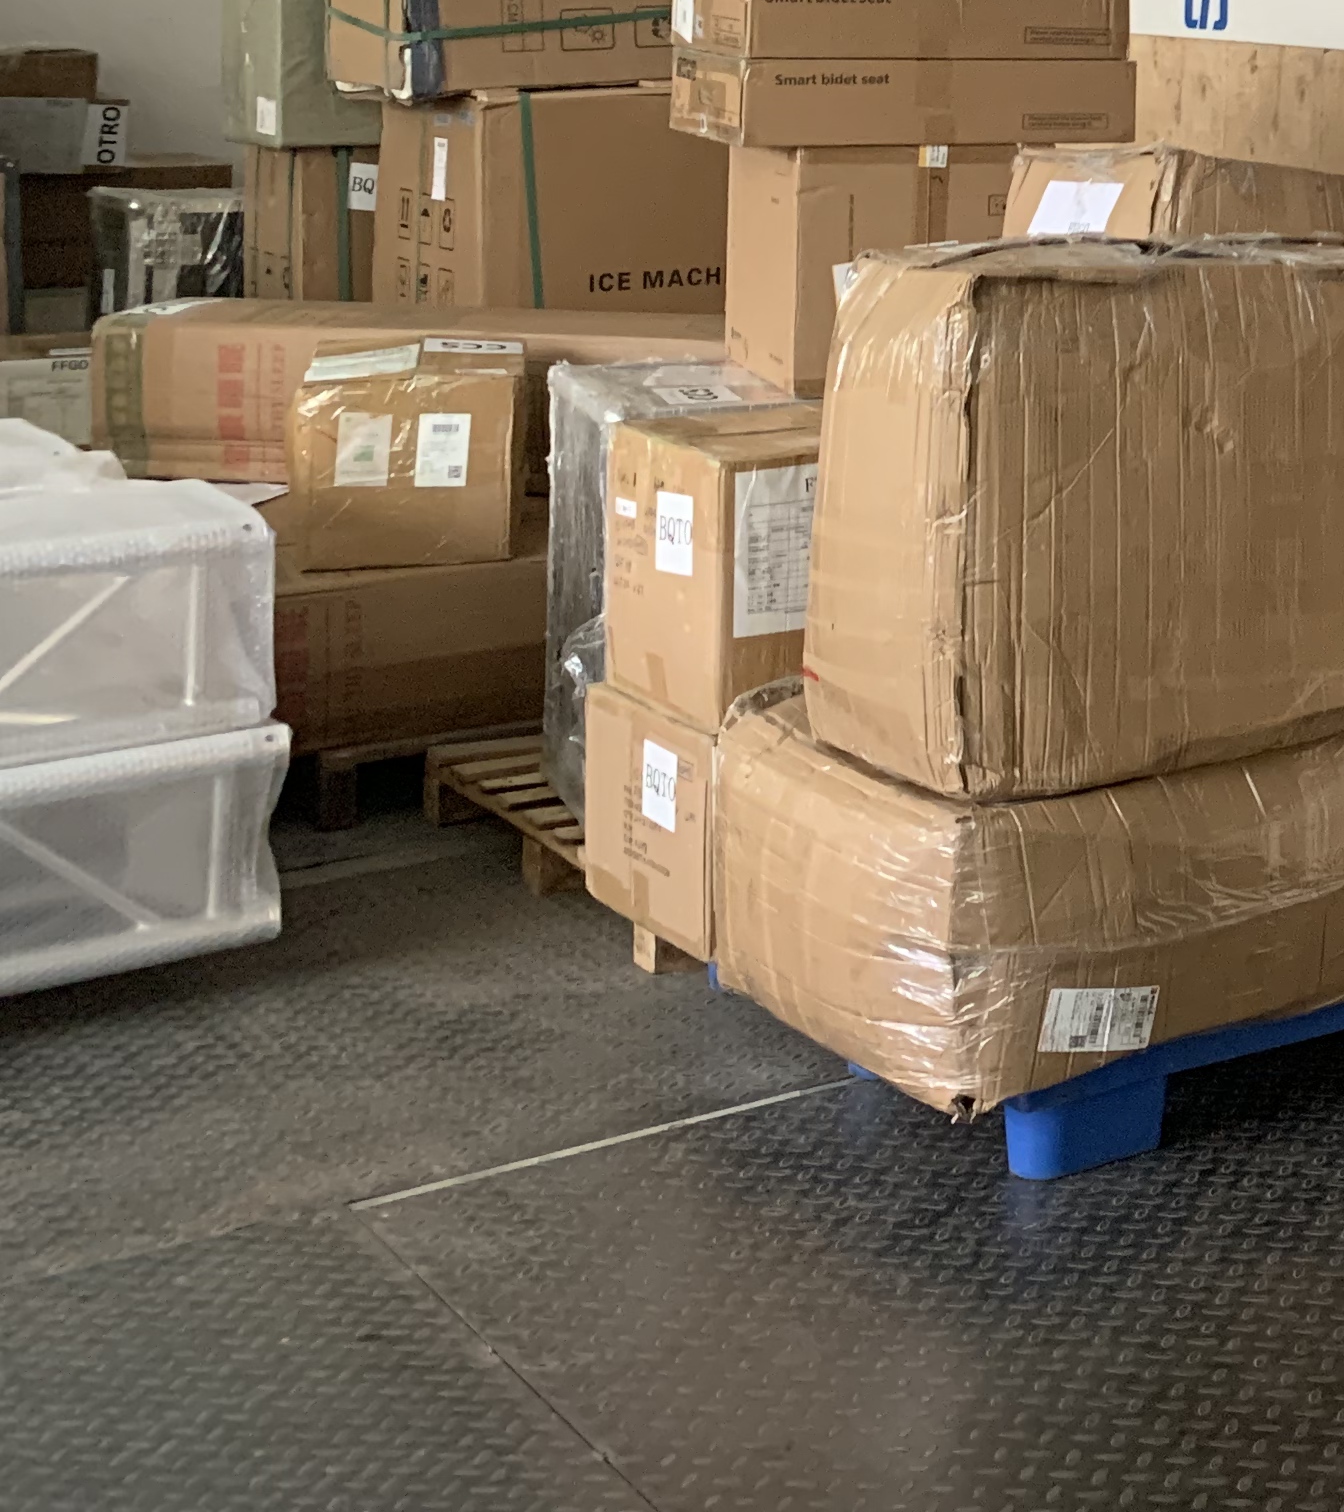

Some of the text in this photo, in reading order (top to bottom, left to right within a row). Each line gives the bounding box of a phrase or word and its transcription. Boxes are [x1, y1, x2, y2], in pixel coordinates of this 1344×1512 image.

[773, 71, 891, 87] Smart bidet seat
[96, 105, 122, 165] OTRO
[589, 271, 632, 294] ICE
[658, 514, 693, 546] BQTO
[645, 763, 677, 803] BQTO
